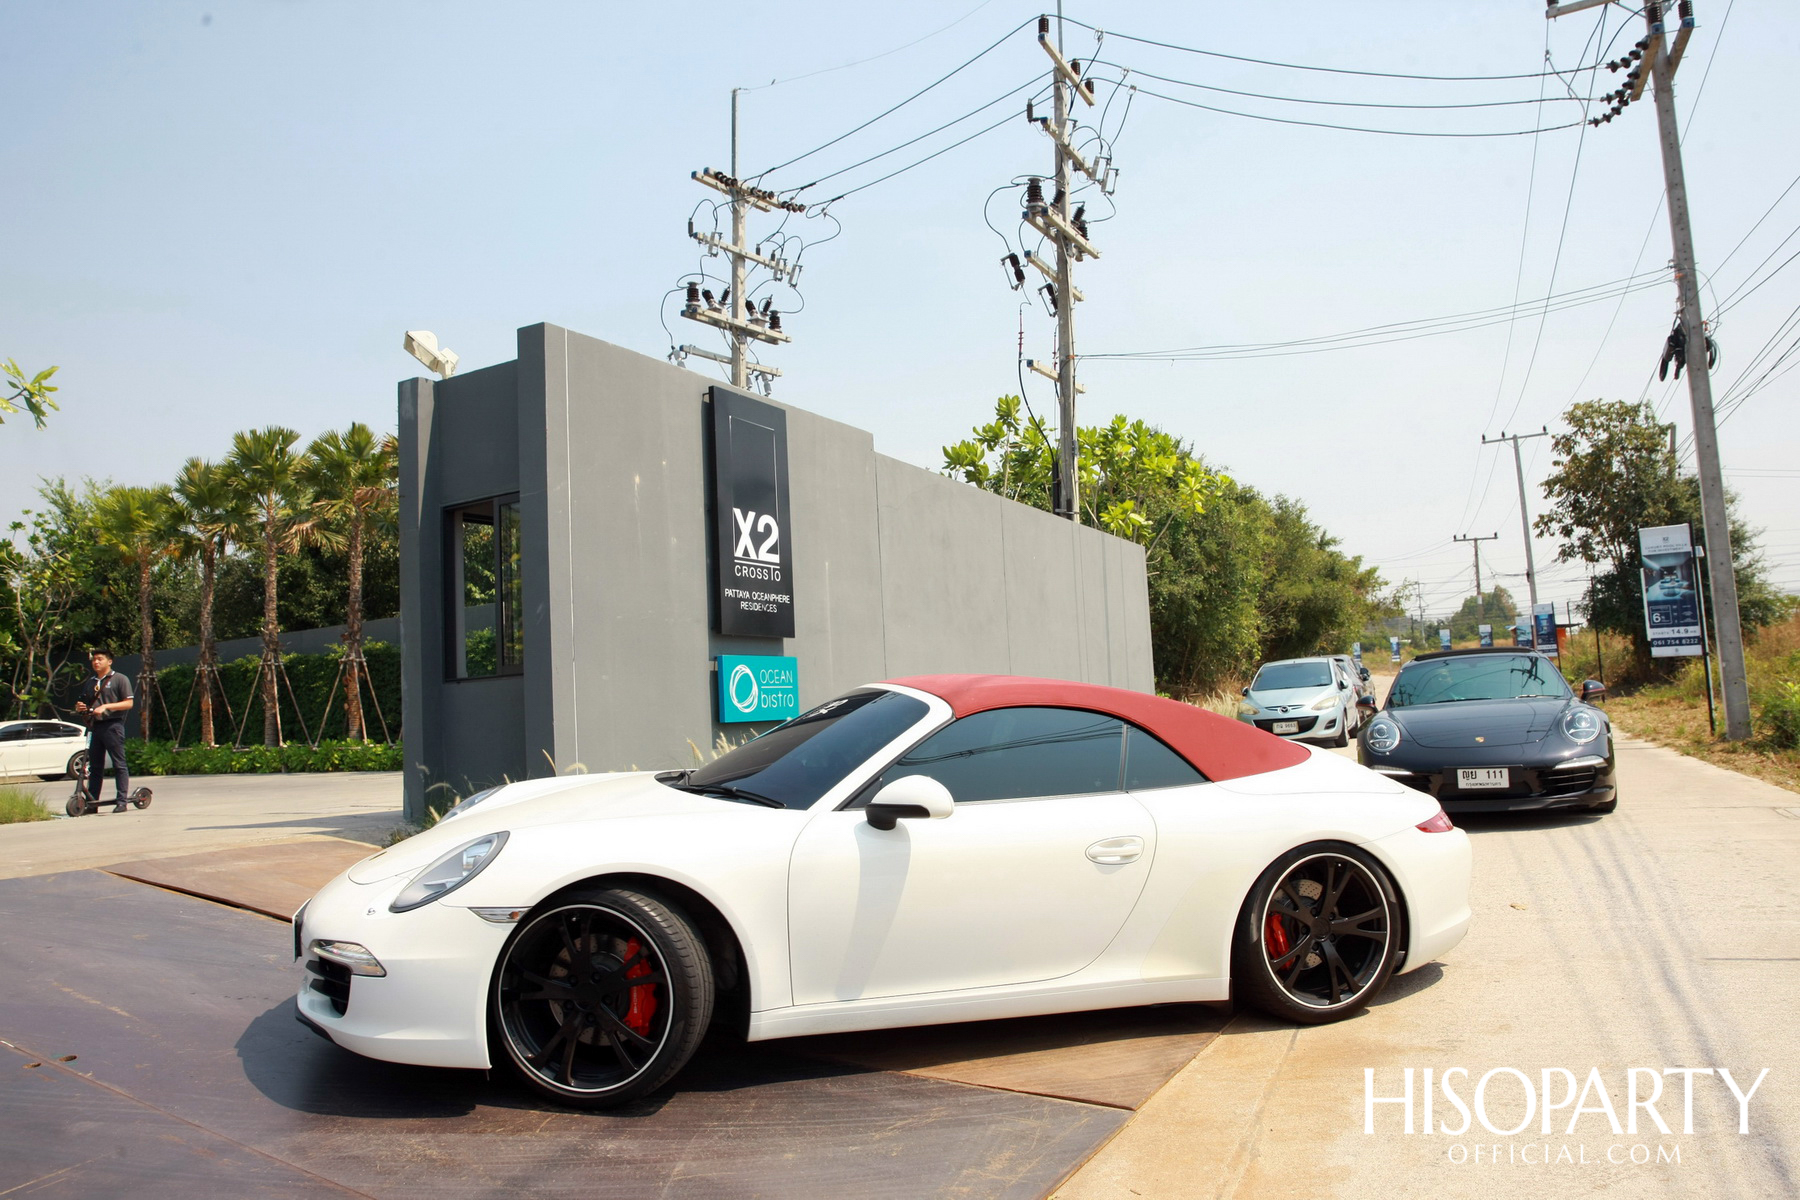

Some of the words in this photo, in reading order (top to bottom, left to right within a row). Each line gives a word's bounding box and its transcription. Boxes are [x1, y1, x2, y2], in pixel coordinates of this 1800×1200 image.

[733, 507, 779, 564] X2
[724, 588, 751, 600] PATTAYA
[751, 591, 791, 604] OCEANPHERE
[740, 601, 778, 613] RESIDENCES
[760, 669, 793, 685] OCEAN
[761, 691, 794, 709] bistro
[1486, 769, 1503, 779] 111
